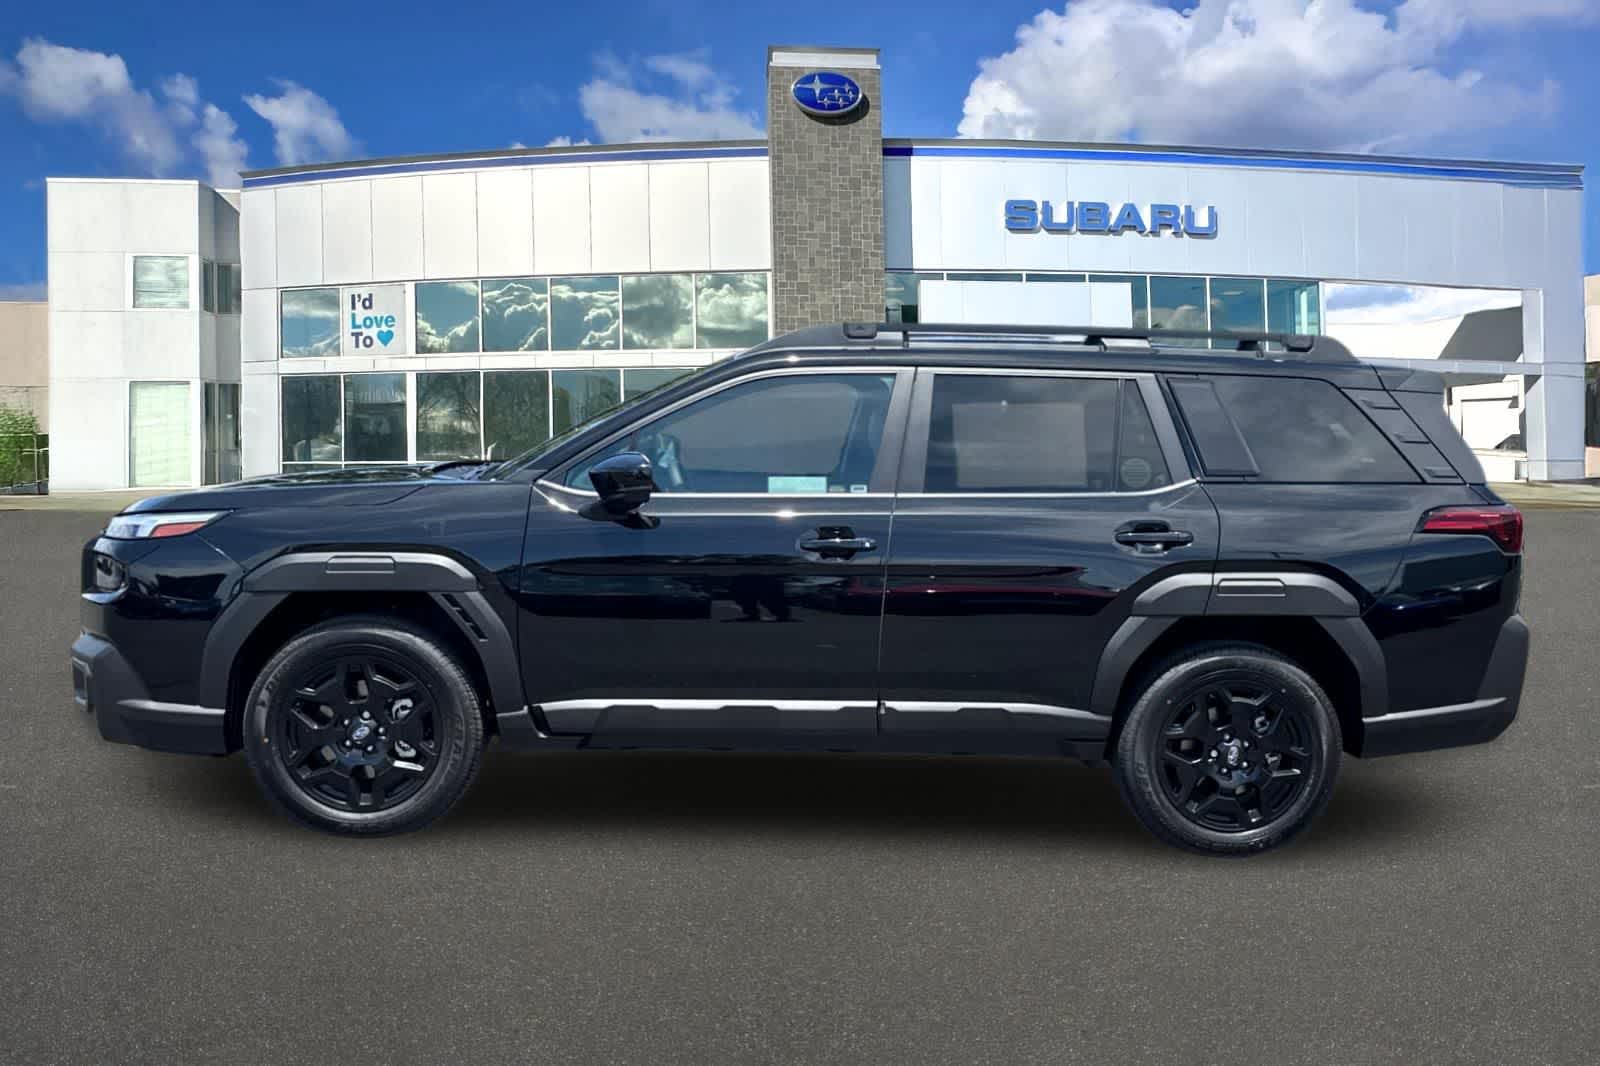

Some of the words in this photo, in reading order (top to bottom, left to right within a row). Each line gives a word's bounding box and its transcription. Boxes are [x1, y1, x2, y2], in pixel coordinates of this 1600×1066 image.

[1005, 200, 1217, 238] SUBARU
[351, 293, 373, 310] I'd
[351, 312, 396, 329] Love
[351, 332, 374, 348] To
